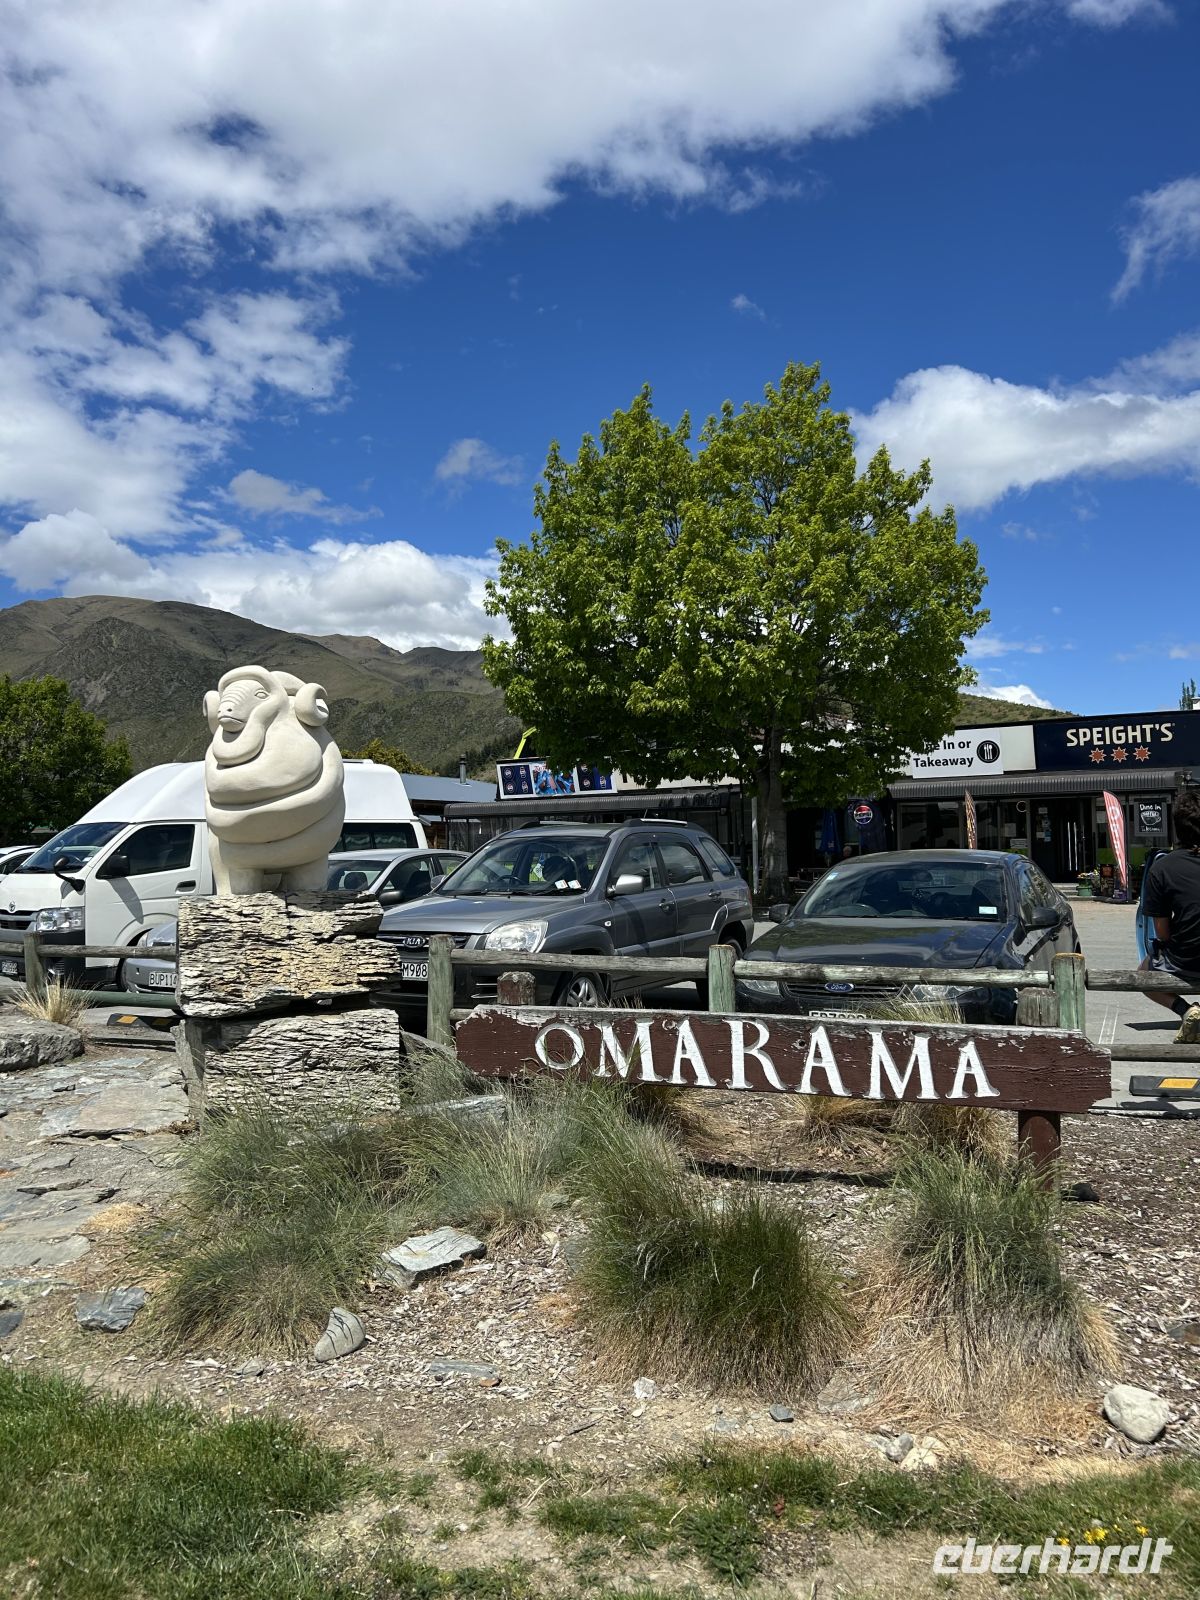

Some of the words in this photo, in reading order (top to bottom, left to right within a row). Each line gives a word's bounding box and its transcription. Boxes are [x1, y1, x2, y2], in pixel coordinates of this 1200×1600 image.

[1066, 722, 1174, 747] SPEIGHT'S
[943, 740, 955, 750] In
[958, 740, 972, 749] or
[913, 756, 974, 768] Takeaway
[406, 937, 421, 945] KIA
[830, 983, 847, 991] Ford
[534, 1018, 1000, 1100] OMARAMA
